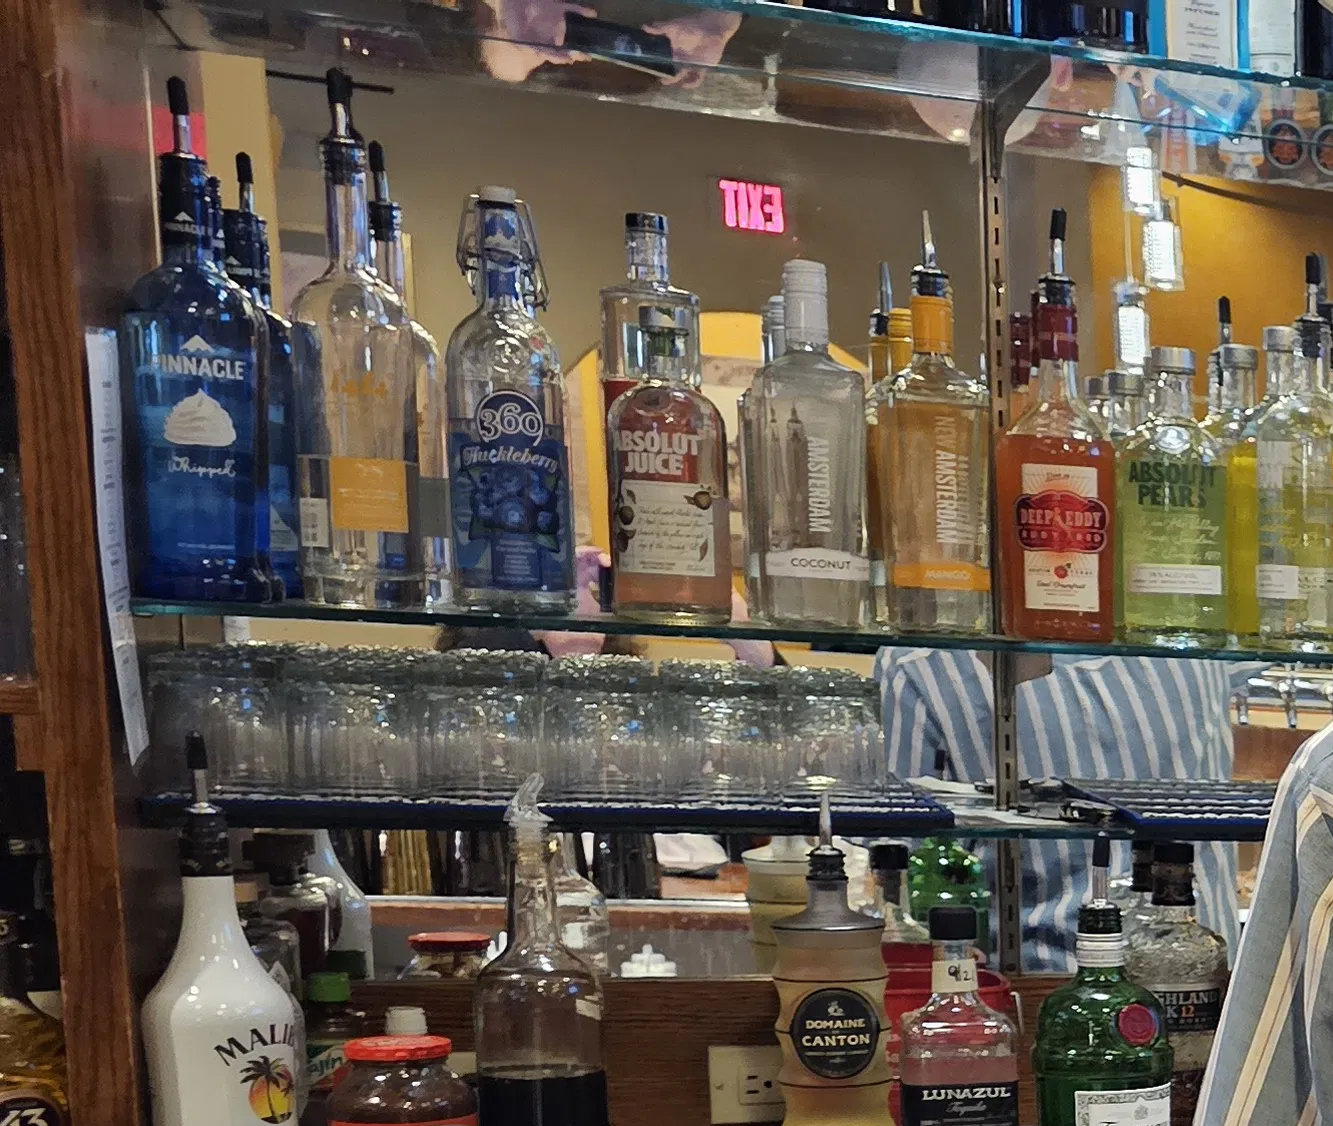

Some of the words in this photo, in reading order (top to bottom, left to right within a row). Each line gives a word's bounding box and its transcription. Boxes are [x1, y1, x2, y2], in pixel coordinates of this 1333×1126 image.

[479, 402, 541, 441] 360
[463, 444, 558, 474] Huckleberry
[624, 451, 684, 476] JUICE
[807, 436, 833, 534] AMSTERDAM
[1128, 460, 1216, 488] ABSOLUT
[935, 449, 963, 544] AMSTERDAM
[1137, 483, 1207, 509] PEARS
[1020, 508, 1053, 525] DEEP
[1065, 511, 1103, 528] EDDY
[790, 557, 852, 571] COCONUT
[1180, 1004, 1196, 1018] 12
[805, 1018, 866, 1030] DOMAINE
[802, 1033, 871, 1047] CANTON
[922, 1086, 1011, 1101] LUNAZUL
